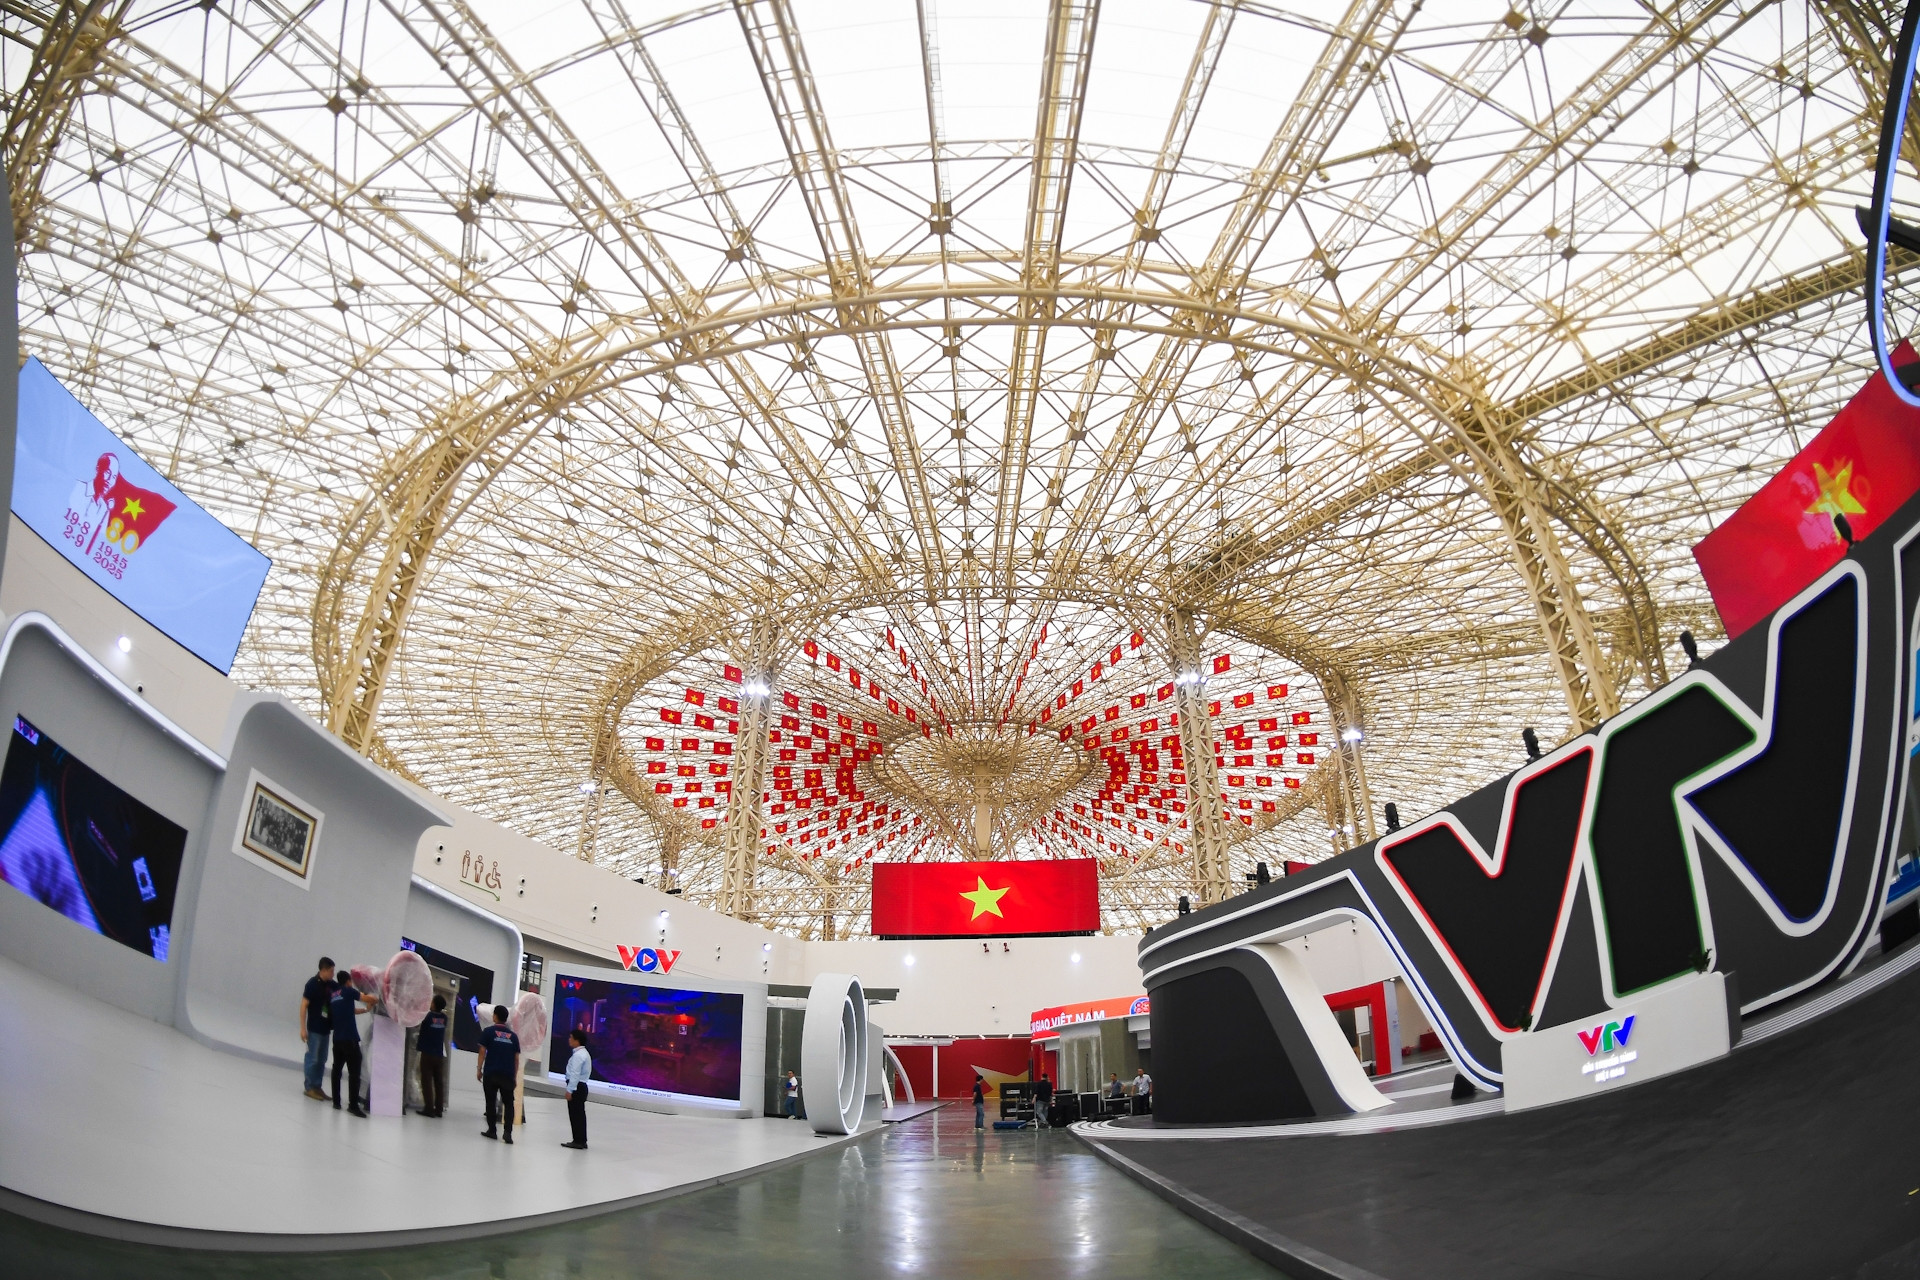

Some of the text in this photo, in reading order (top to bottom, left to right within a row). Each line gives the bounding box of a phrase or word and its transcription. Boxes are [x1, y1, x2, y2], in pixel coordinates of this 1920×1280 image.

[63, 508, 91, 535] 19-8
[63, 524, 85, 548] 2-9
[106, 517, 140, 555] 80
[93, 551, 123, 580] 2025
[98, 541, 128, 569] 1945
[1374, 559, 1868, 1042] VTV
[616, 944, 682, 975] VOV
[560, 979, 583, 991] VOV
[1576, 1014, 1636, 1057] VTV
